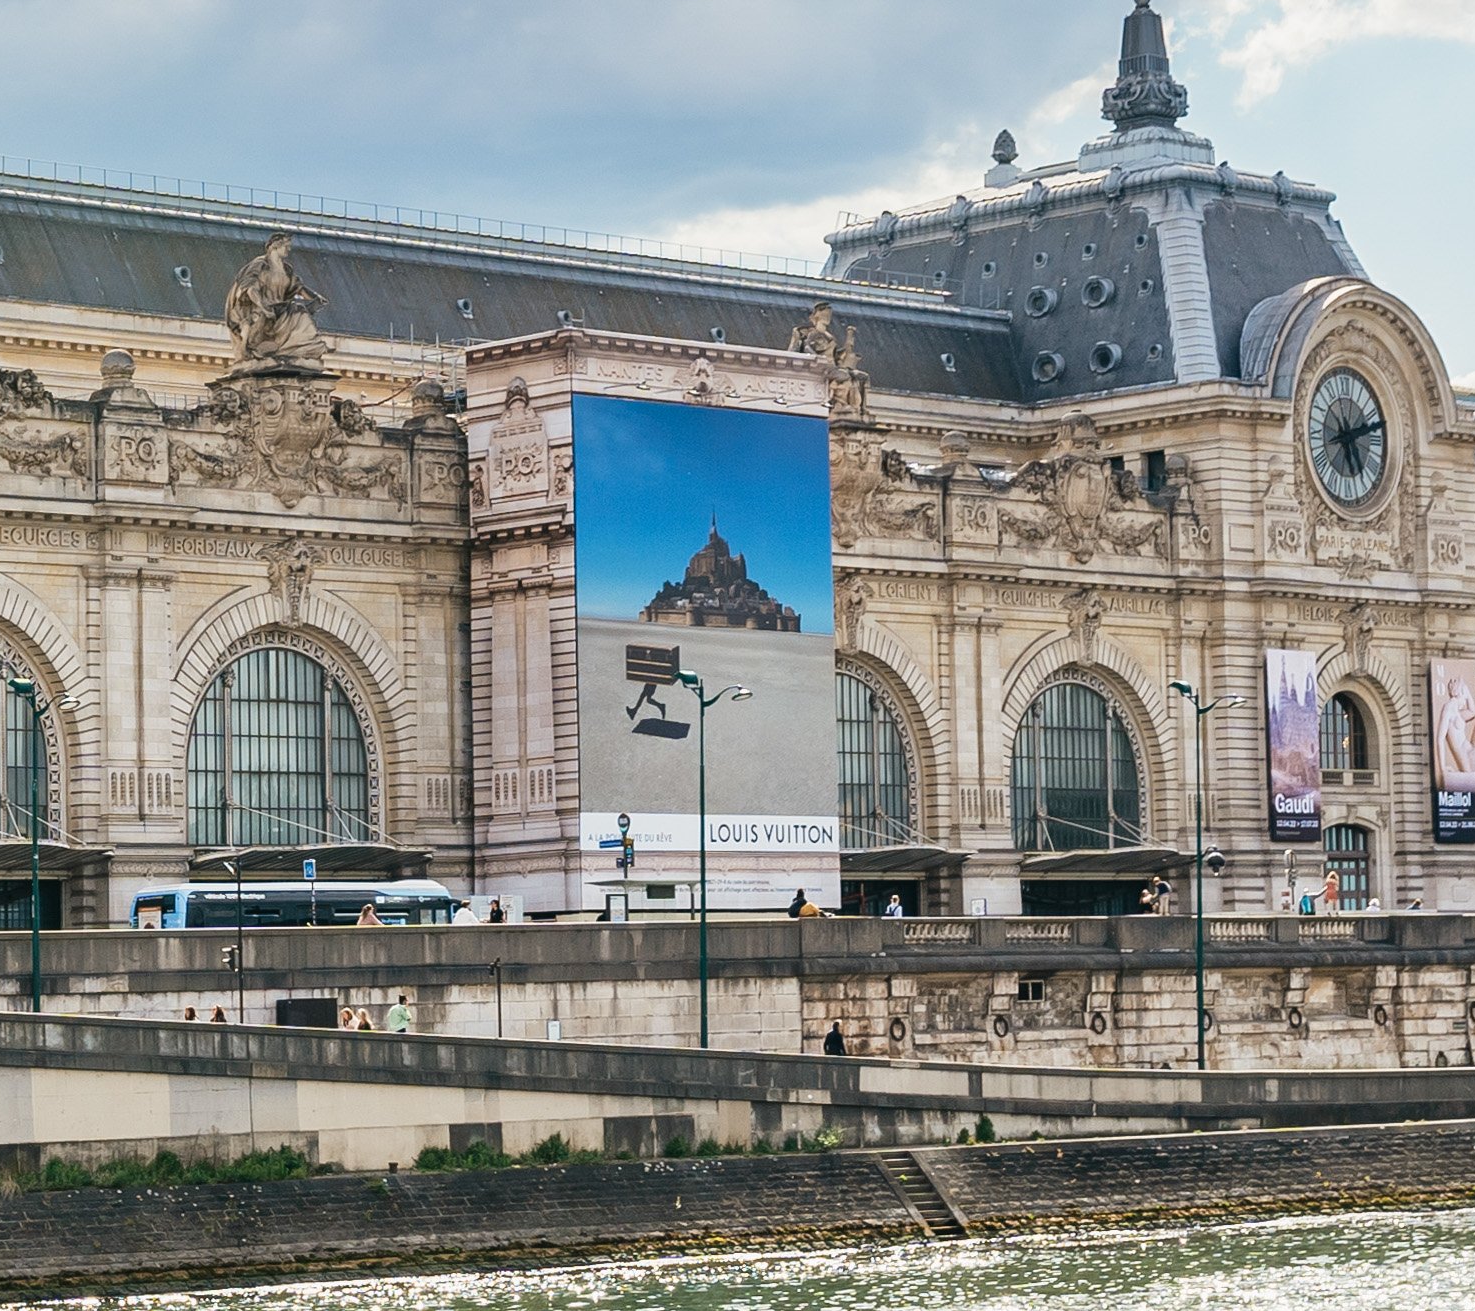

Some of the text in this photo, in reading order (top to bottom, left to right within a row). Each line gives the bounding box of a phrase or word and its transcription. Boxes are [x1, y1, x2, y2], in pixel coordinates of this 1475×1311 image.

[598, 364, 663, 382] NANTES
[120, 436, 156, 462] PO
[436, 462, 464, 485] PO
[501, 453, 534, 475] PO
[963, 504, 990, 529] PO
[1189, 524, 1211, 545] PO
[1275, 527, 1299, 548] PO
[173, 537, 402, 567] BORDEAUX TOULOUSE
[1438, 540, 1460, 561] PO
[878, 583, 937, 601] LORIENT
[1001, 590, 1059, 608] QUIMPER
[1274, 793, 1314, 813] Gaudí
[1439, 791, 1472, 807] Maillol
[710, 824, 834, 845] LOUIS VUITTON
